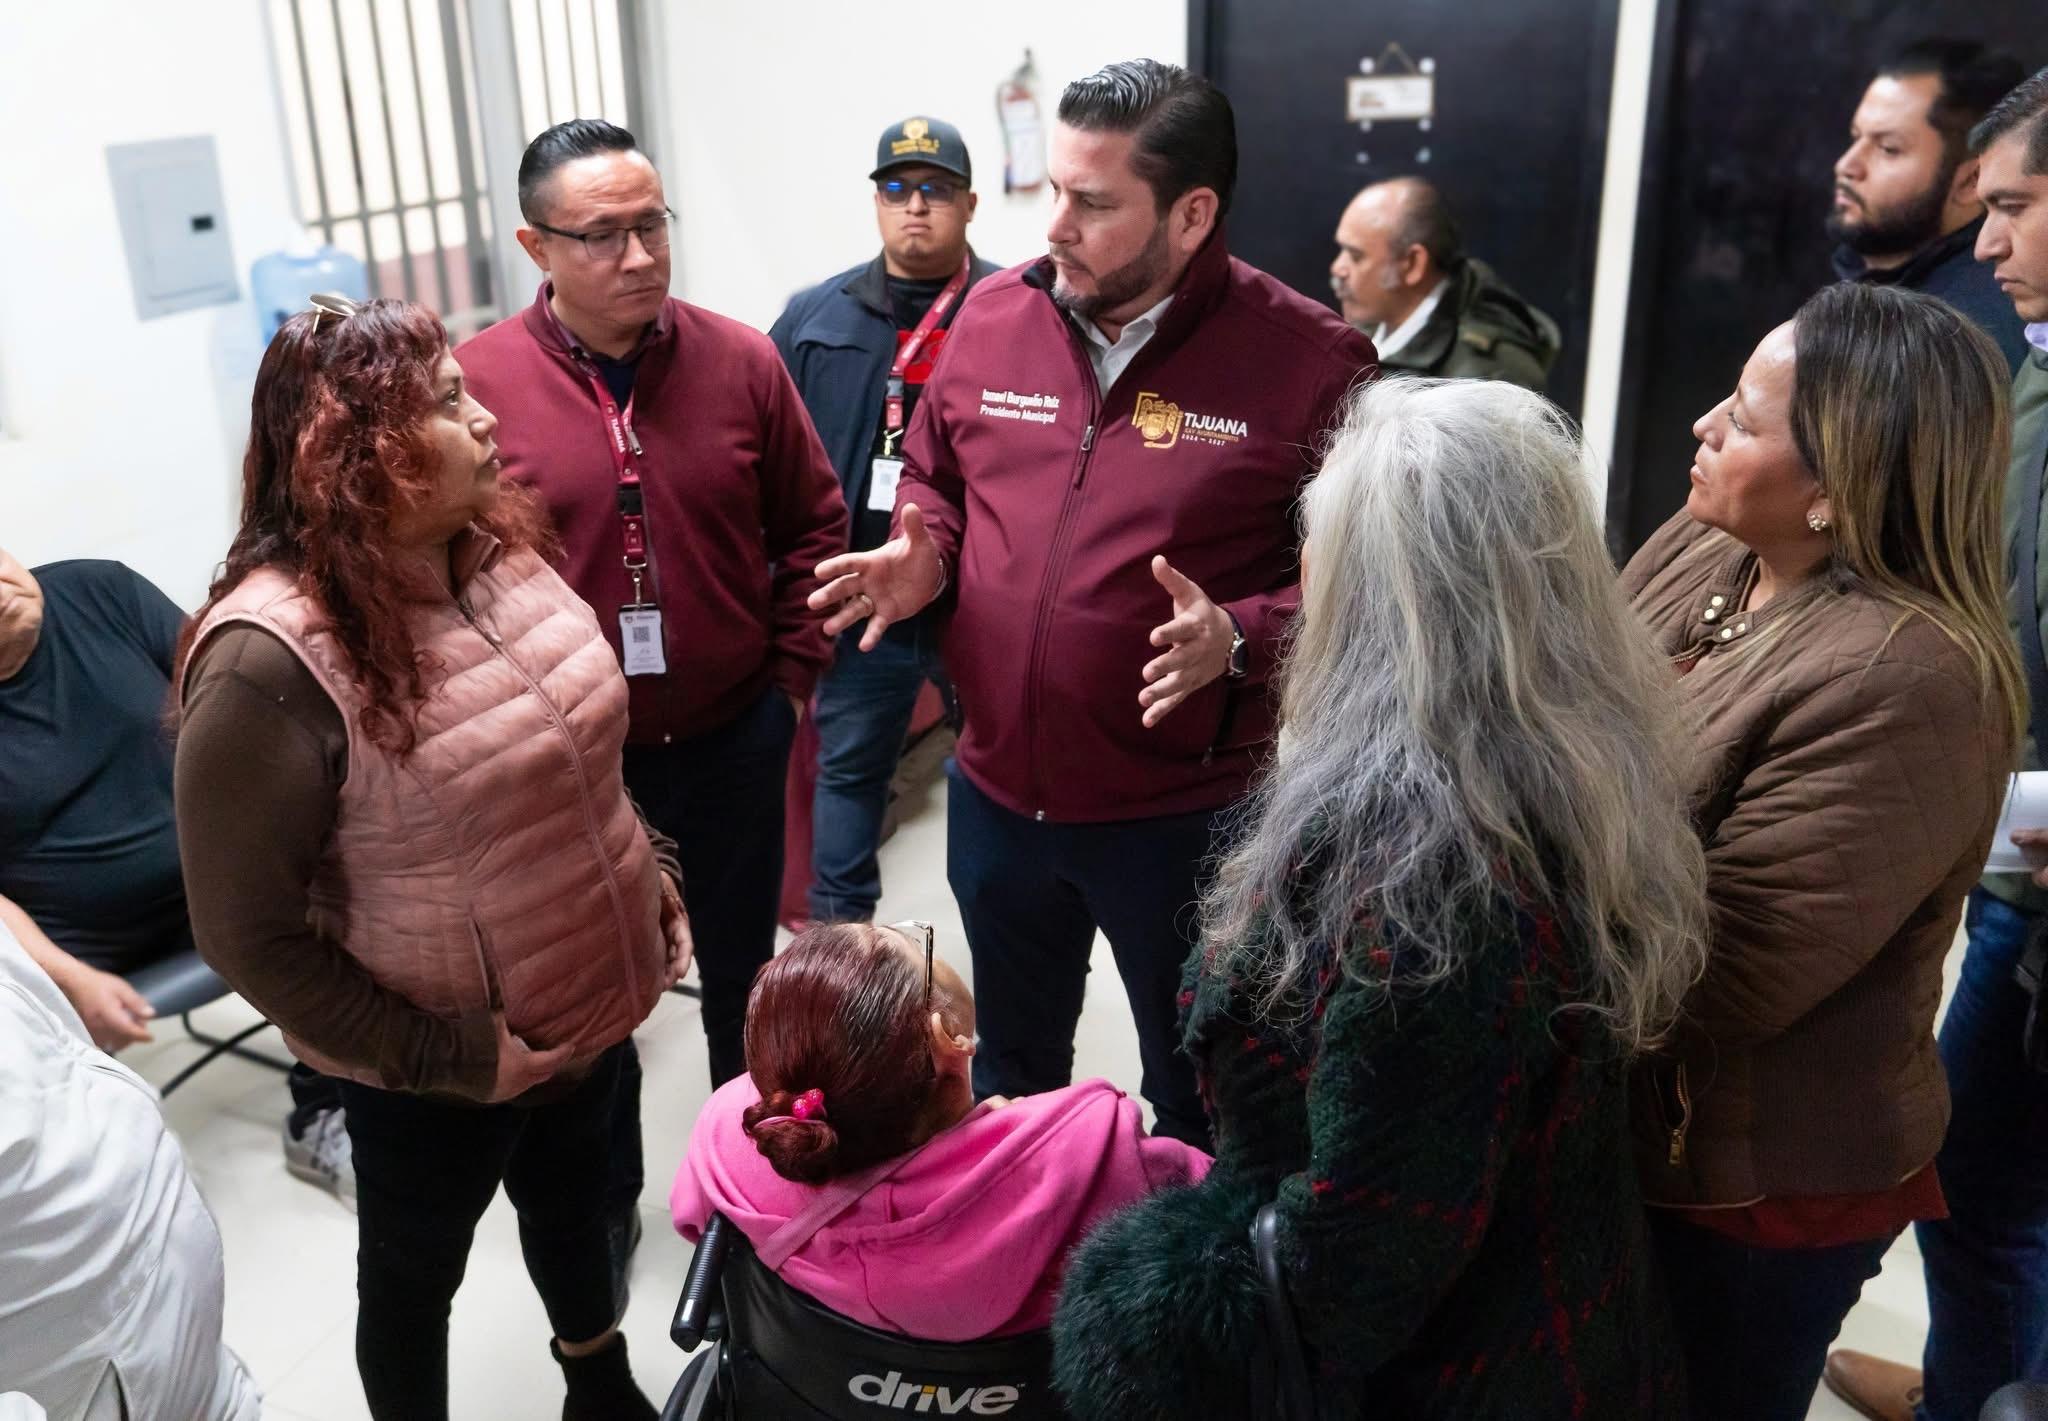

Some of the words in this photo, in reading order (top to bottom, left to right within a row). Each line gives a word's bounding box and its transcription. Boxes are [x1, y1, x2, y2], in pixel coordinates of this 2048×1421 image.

[980, 404, 1021, 419] Presidente
[1021, 409, 1056, 425] Municipal
[1184, 412, 1248, 437] TIJUANA
[848, 1370, 1020, 1415] drive
